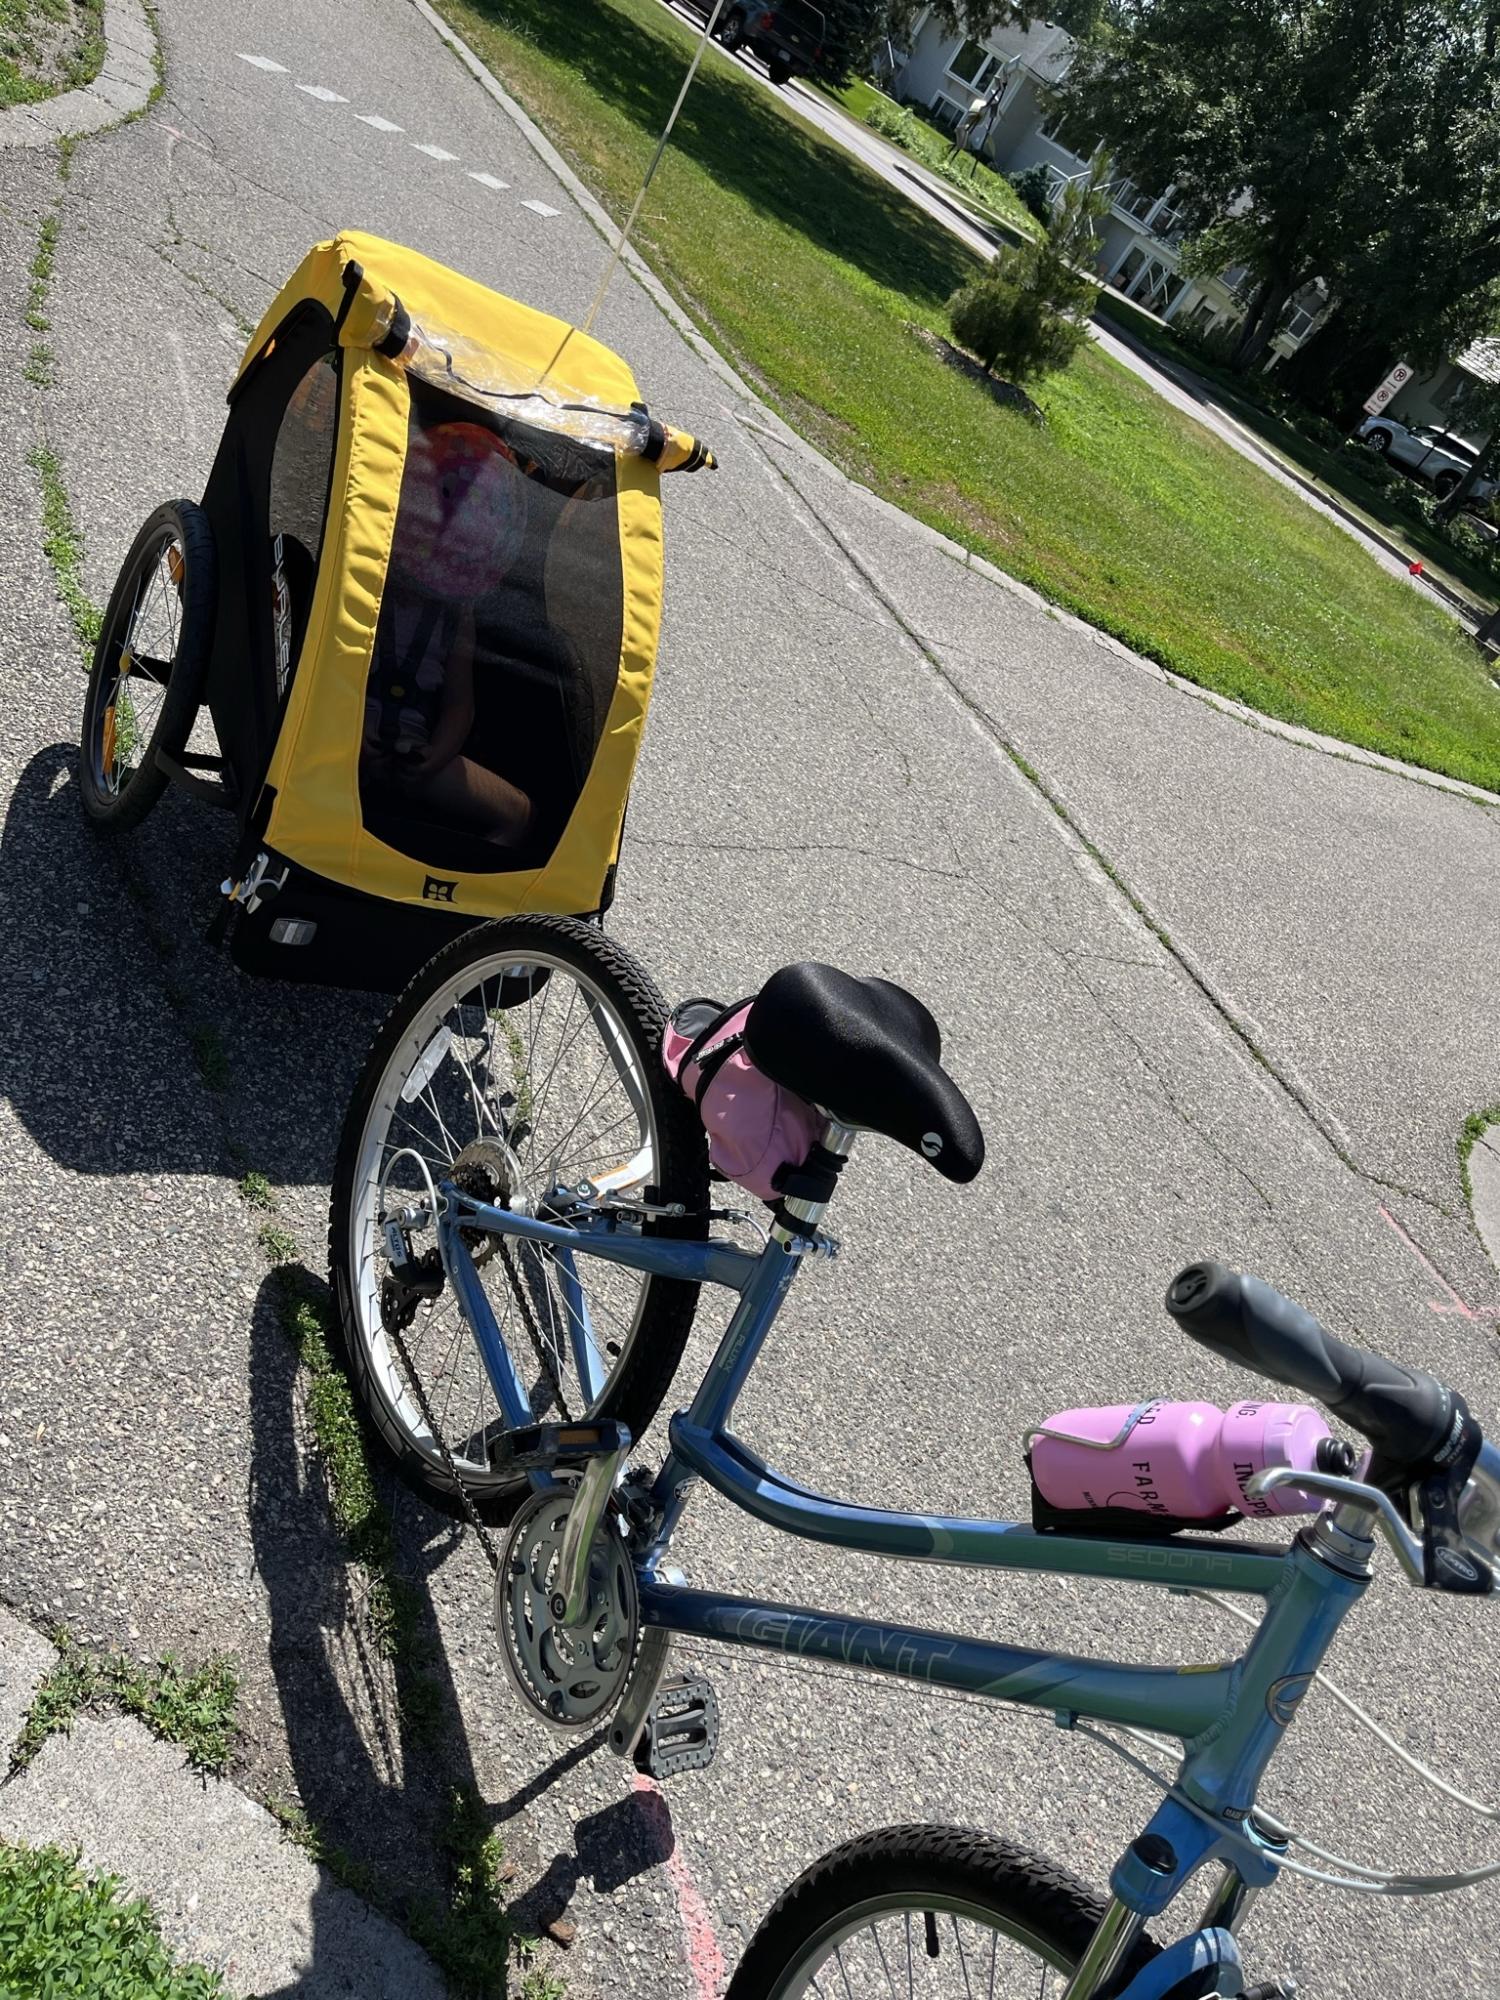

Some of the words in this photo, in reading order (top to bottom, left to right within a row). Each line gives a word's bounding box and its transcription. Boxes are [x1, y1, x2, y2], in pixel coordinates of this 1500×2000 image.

[391, 1226, 403, 1257] ALTUS
[1106, 1546, 1233, 1574] SEDONA
[736, 1608, 958, 1682] GIANT
